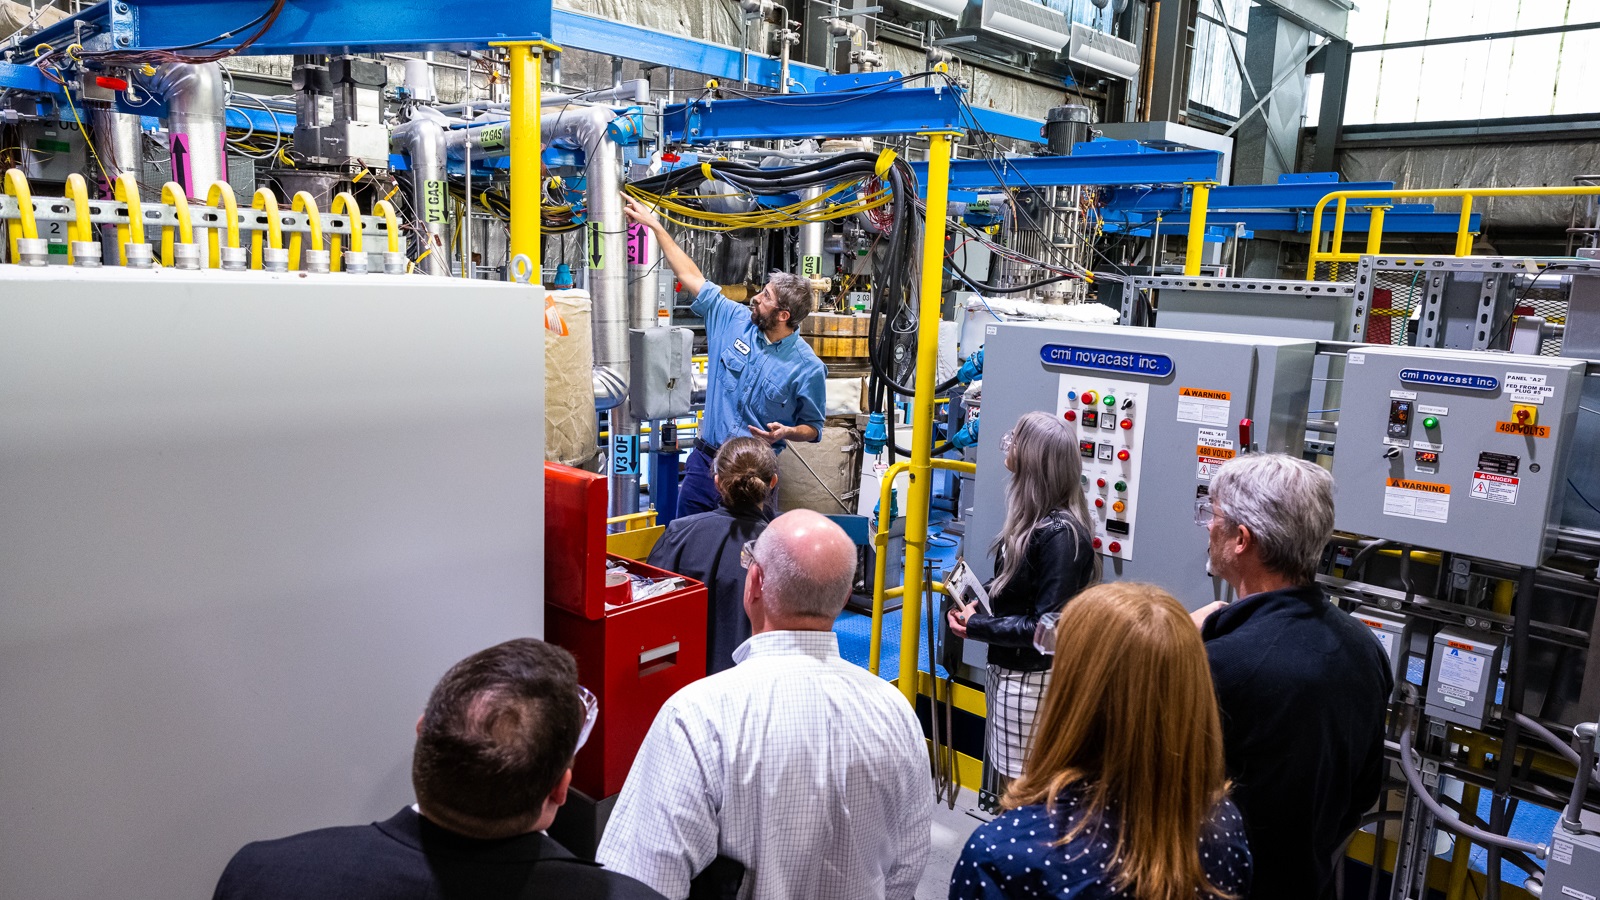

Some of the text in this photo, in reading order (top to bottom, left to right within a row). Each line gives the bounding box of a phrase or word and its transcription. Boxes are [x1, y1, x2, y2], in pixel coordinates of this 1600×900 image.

[480, 128, 503, 142] V2 GAS
[428, 181, 440, 223] V1 GAS
[50, 223, 61, 234] 2
[628, 245, 636, 263] V3
[805, 256, 814, 274] GAS
[1050, 348, 1160, 370] cmi novacast inc.
[1401, 371, 1496, 387] cmi novacast inc.
[1191, 390, 1227, 400] WARNING
[1500, 423, 1545, 437] 480 VOLTS
[615, 435, 628, 473] V3 OF
[1199, 447, 1233, 459] 480 VOLTS
[1486, 474, 1513, 484] DANGER
[1401, 481, 1446, 493] WARNING
